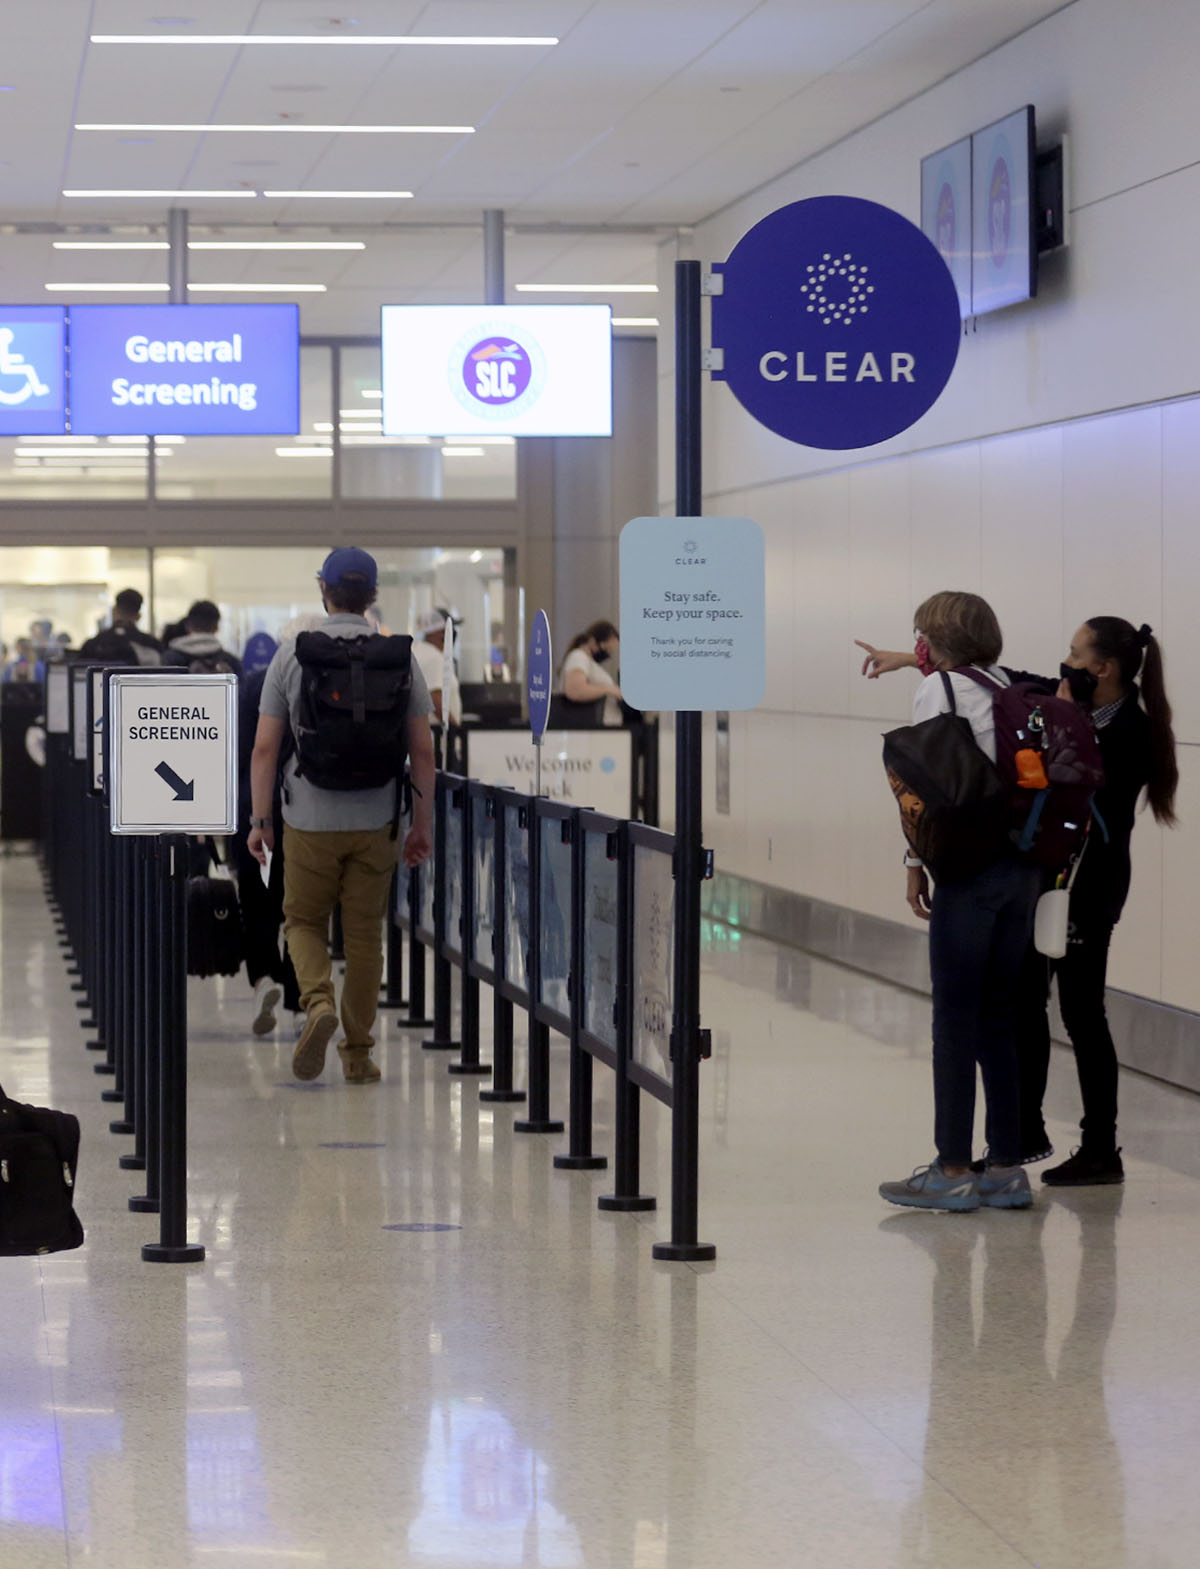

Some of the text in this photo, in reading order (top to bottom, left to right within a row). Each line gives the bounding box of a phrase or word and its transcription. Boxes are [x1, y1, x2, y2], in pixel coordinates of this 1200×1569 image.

[125, 333, 242, 363] General
[758, 350, 916, 383] CLEAR
[475, 360, 517, 398] SLC
[111, 377, 257, 411] Screening
[664, 590, 720, 604] Stay safe.
[643, 608, 743, 621] Keep your space.
[651, 637, 733, 647] Thank you for caring
[651, 650, 661, 658] by
[663, 649, 686, 658] social
[138, 707, 210, 720] GENERAL
[129, 726, 219, 740] SCREENING
[505, 755, 593, 773] Wecome
